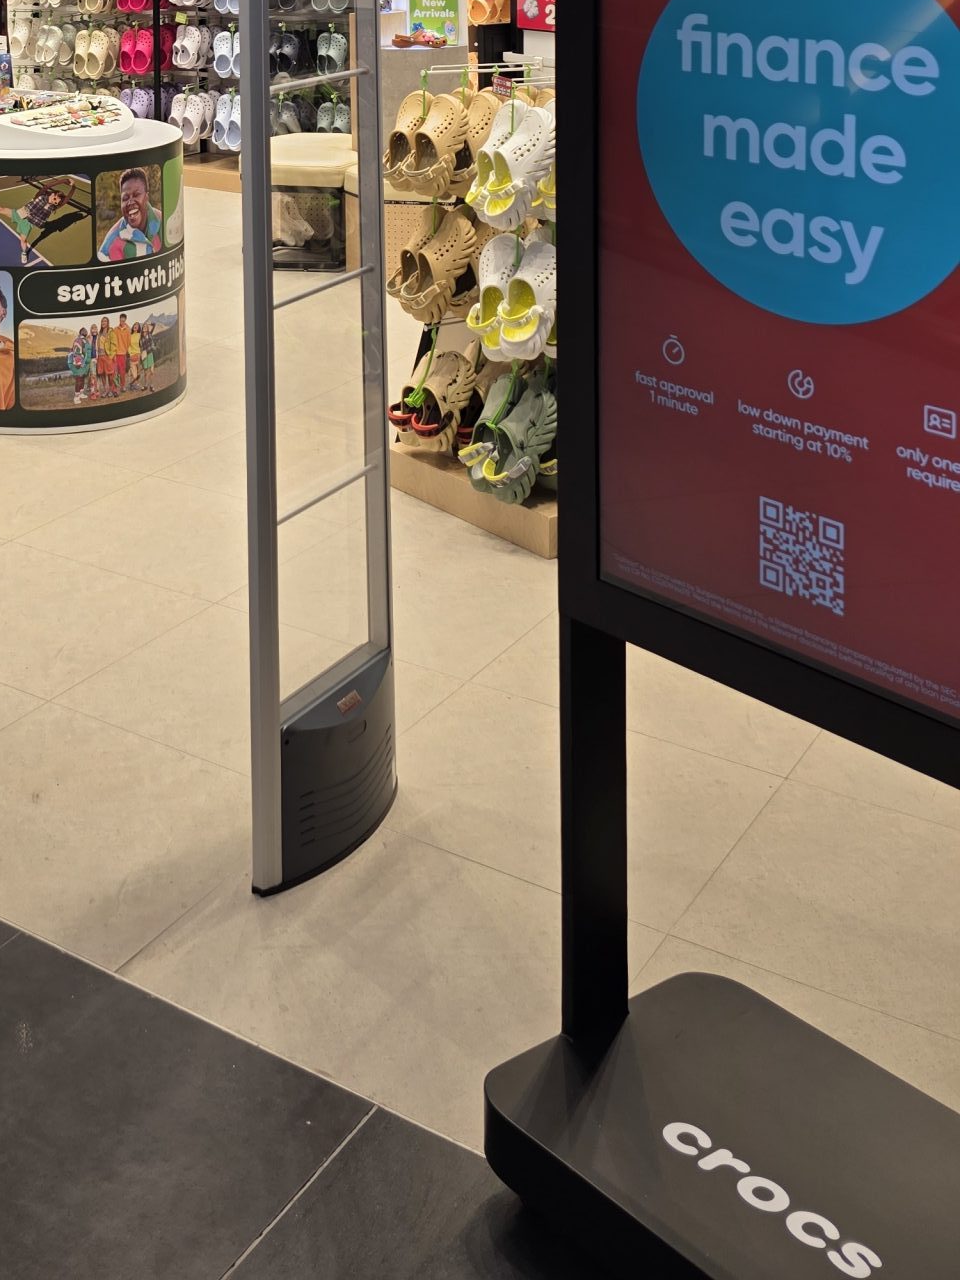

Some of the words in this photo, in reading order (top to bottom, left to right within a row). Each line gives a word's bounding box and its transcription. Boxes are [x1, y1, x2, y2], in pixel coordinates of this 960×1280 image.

[413, 9, 455, 18] Arrivals
[677, 12, 940, 97] finance
[702, 114, 906, 185] made
[720, 200, 884, 286] easy
[57, 282, 99, 305] say
[104, 275, 123, 299] it
[126, 263, 166, 294] with
[635, 370, 657, 387] fast
[659, 380, 714, 405] approval
[649, 390, 655, 403] 1
[657, 394, 699, 416] minute
[737, 399, 760, 418] low
[763, 408, 801, 430] down
[804, 422, 869, 450] payment
[752, 423, 803, 451] starting
[806, 440, 822, 454] at
[825, 442, 852, 463] 10%
[896, 446, 929, 467] only
[931, 456, 960, 474] one
[662, 1121, 883, 1279] crocs
